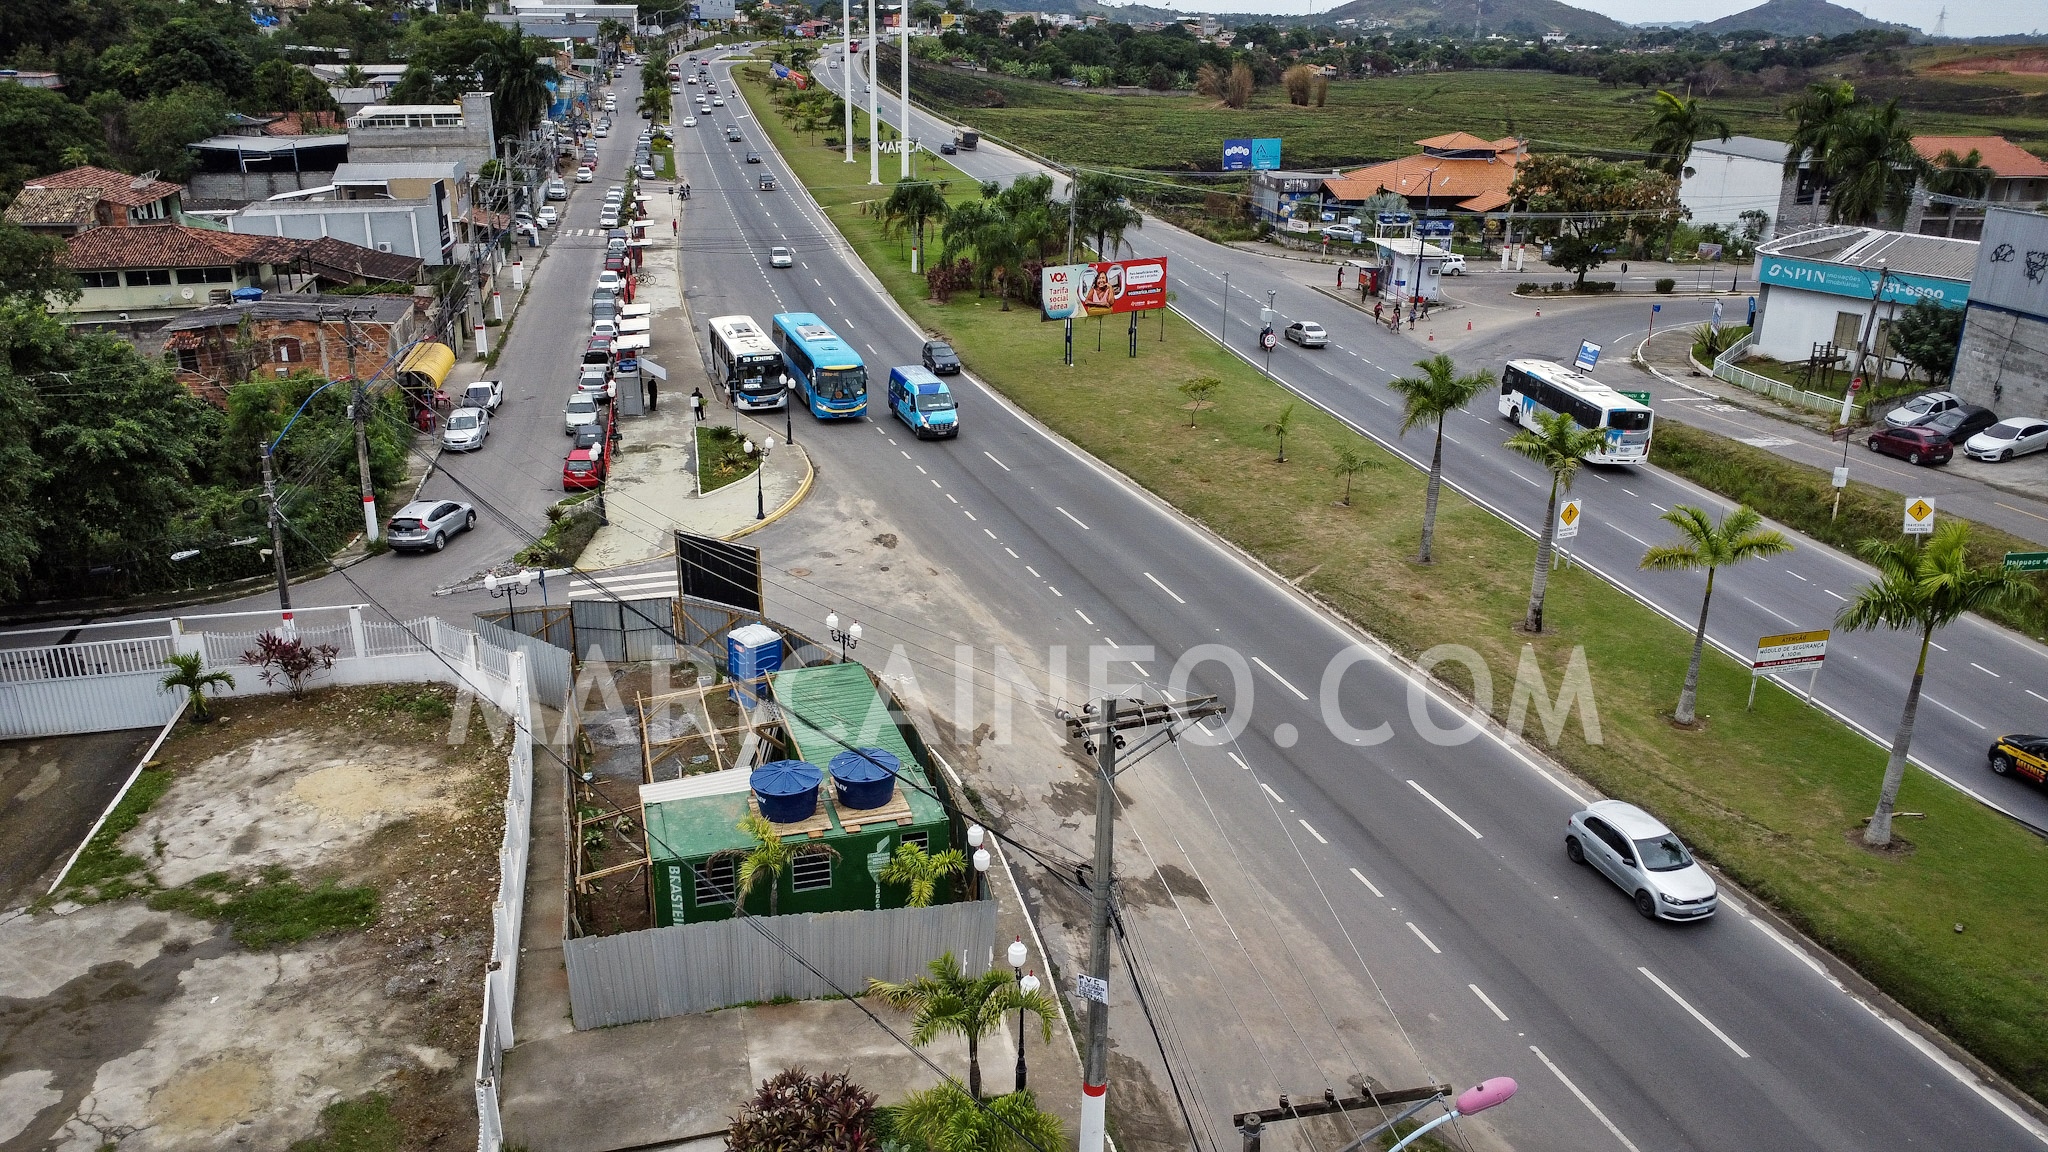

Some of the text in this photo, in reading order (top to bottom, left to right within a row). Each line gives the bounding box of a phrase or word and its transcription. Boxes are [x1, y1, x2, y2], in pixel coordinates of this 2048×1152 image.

[877, 136, 924, 154] MARCÁ
[1049, 272, 1068, 282] VOA
[1782, 265, 1826, 284] SPIN
[1049, 287, 1069, 295] Tarifa
[1049, 294, 1069, 303] social
[1782, 635, 1807, 643] ATENÇÃO
[1792, 642, 1824, 651] SEGURANÇA
[2016, 758, 2047, 779] MUNIZ
